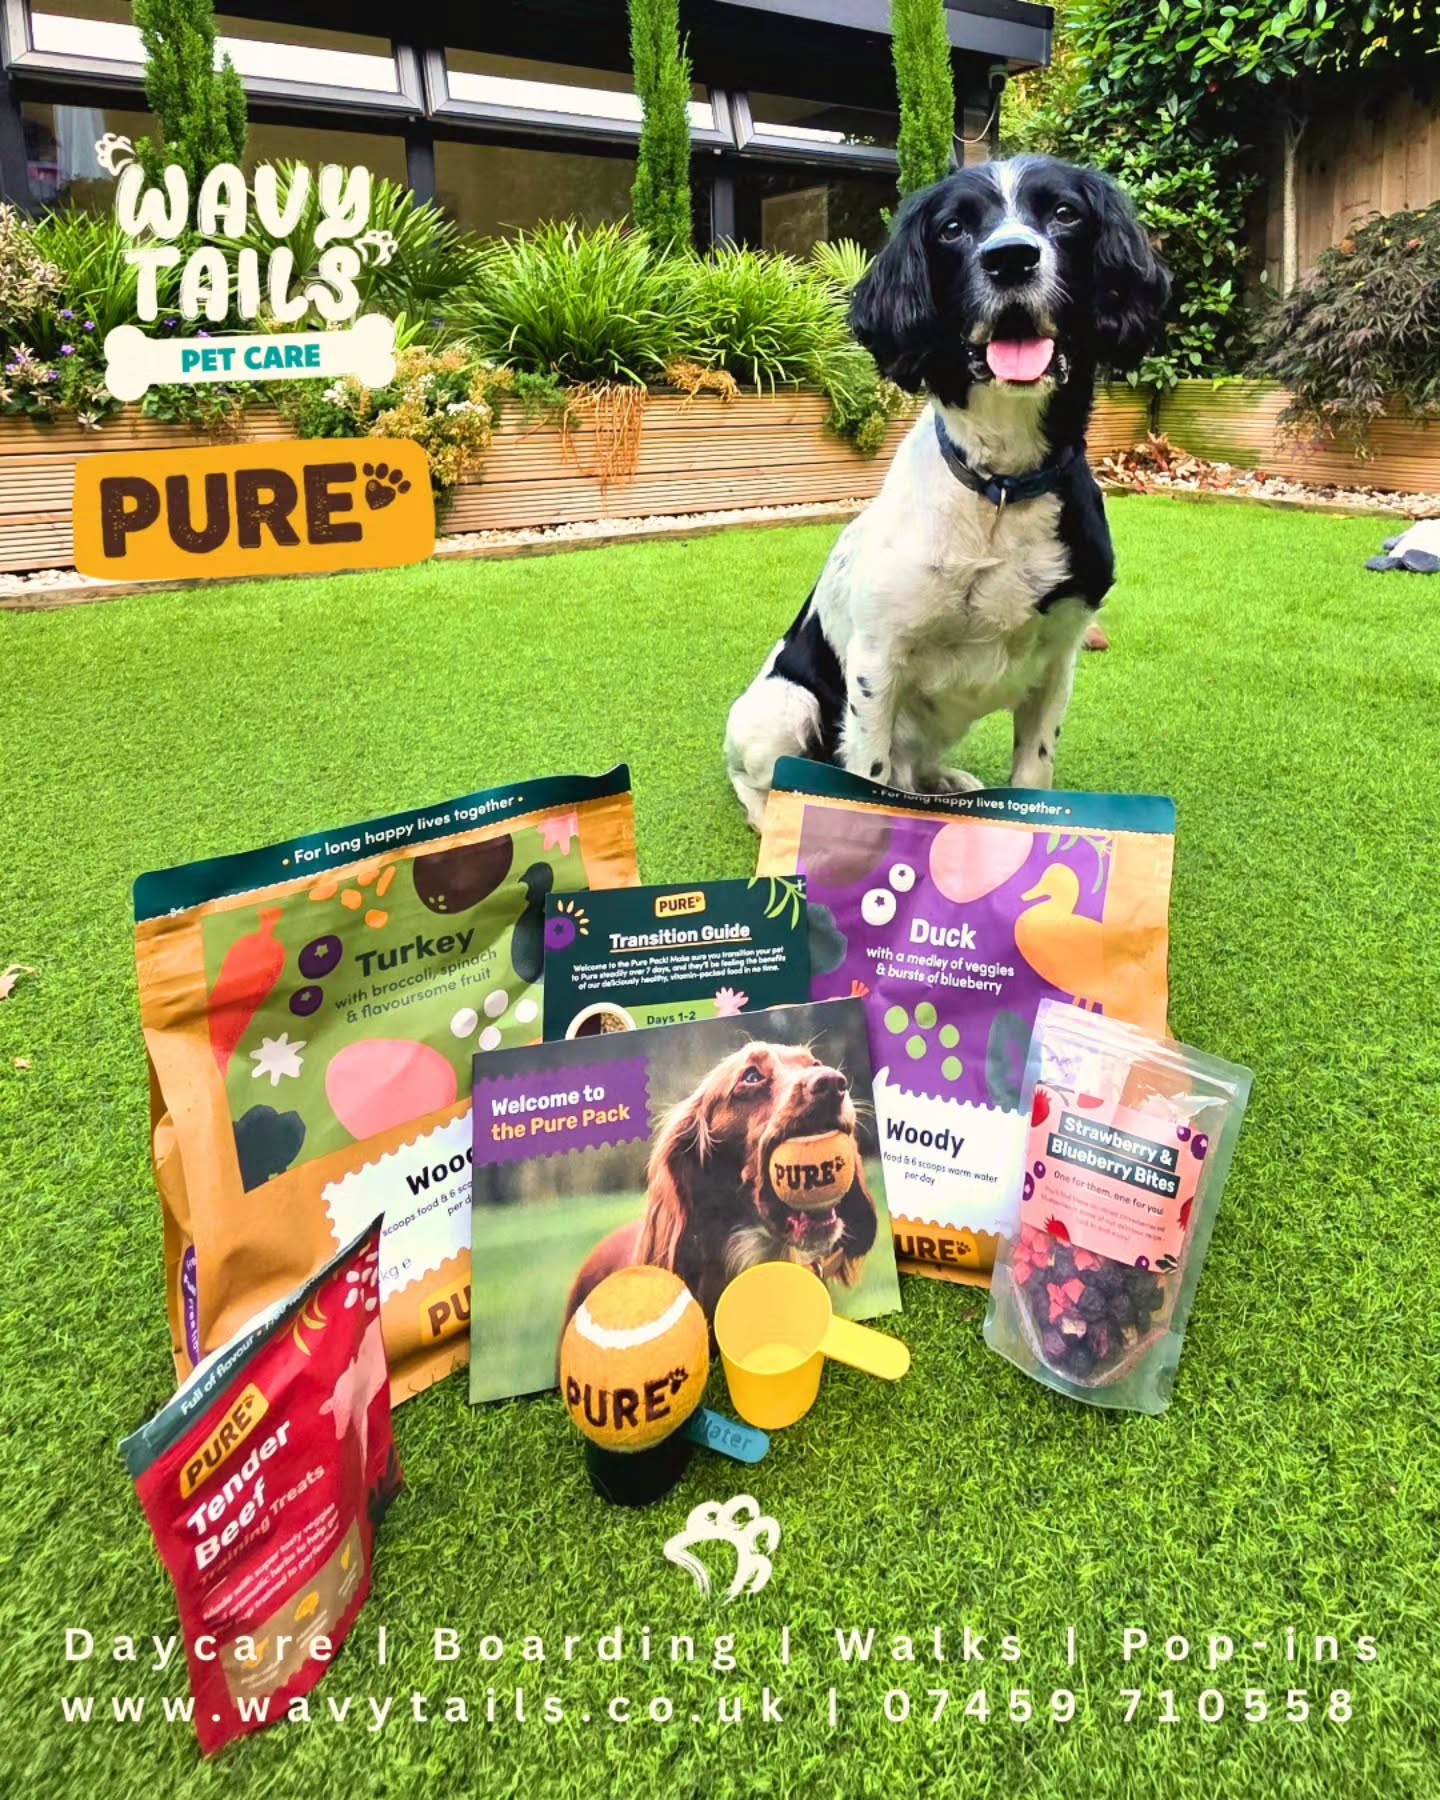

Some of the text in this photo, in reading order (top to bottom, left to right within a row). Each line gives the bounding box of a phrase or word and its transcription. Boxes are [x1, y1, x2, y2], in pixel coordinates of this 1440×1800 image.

[881, 789, 900, 799] For
[934, 795, 973, 809] happy
[976, 798, 1004, 810] lives
[1007, 799, 1062, 816] together
[294, 796, 515, 864] For long happy lives together
[659, 897, 696, 912] PURE
[355, 927, 475, 977] Turkey
[609, 923, 751, 949] Transition Guide
[909, 918, 977, 950] Duck
[571, 974, 580, 982] to
[629, 968, 645, 976] over
[672, 963, 687, 971] and
[573, 963, 607, 972] Welcome
[617, 960, 630, 968] the
[631, 959, 648, 967] Pure
[756, 948, 771, 957] your
[866, 946, 1015, 978] with a medley of veggies
[876, 963, 1002, 995] & bursts of blueberry
[335, 949, 497, 1010] with broccoli, spinach
[346, 967, 491, 1024] & flavoursome fruit
[647, 1011, 697, 1026] Days 1-2
[491, 1084, 605, 1117] Welcome to
[491, 1103, 631, 1141] the Pure Pack
[886, 1118, 965, 1158] Woody
[1064, 1116, 1173, 1167] Strawberry &
[774, 1160, 836, 1190] PURE
[883, 1151, 902, 1164] food
[911, 1157, 917, 1167] 6
[918, 1160, 946, 1173] scoops
[947, 1167, 971, 1178] warm
[973, 1171, 999, 1184] water
[904, 1170, 936, 1186] per day
[1051, 1138, 1176, 1194] Blueberry Bites
[447, 1200, 463, 1217] per
[1054, 1170, 1071, 1182] One
[1072, 1175, 1085, 1187] for
[1114, 1192, 1131, 1204] one
[1132, 1197, 1145, 1209] for
[382, 1213, 416, 1237] scoops
[417, 1197, 439, 1216] food
[449, 1189, 456, 1199] 6
[180, 1335, 254, 1416] Full of flavour
[566, 1375, 671, 1430] PURE
[186, 1403, 252, 1490] PURE
[186, 1420, 291, 1536] Tender
[270, 1465, 325, 1516] Treats
[194, 1476, 266, 1571] Beef
